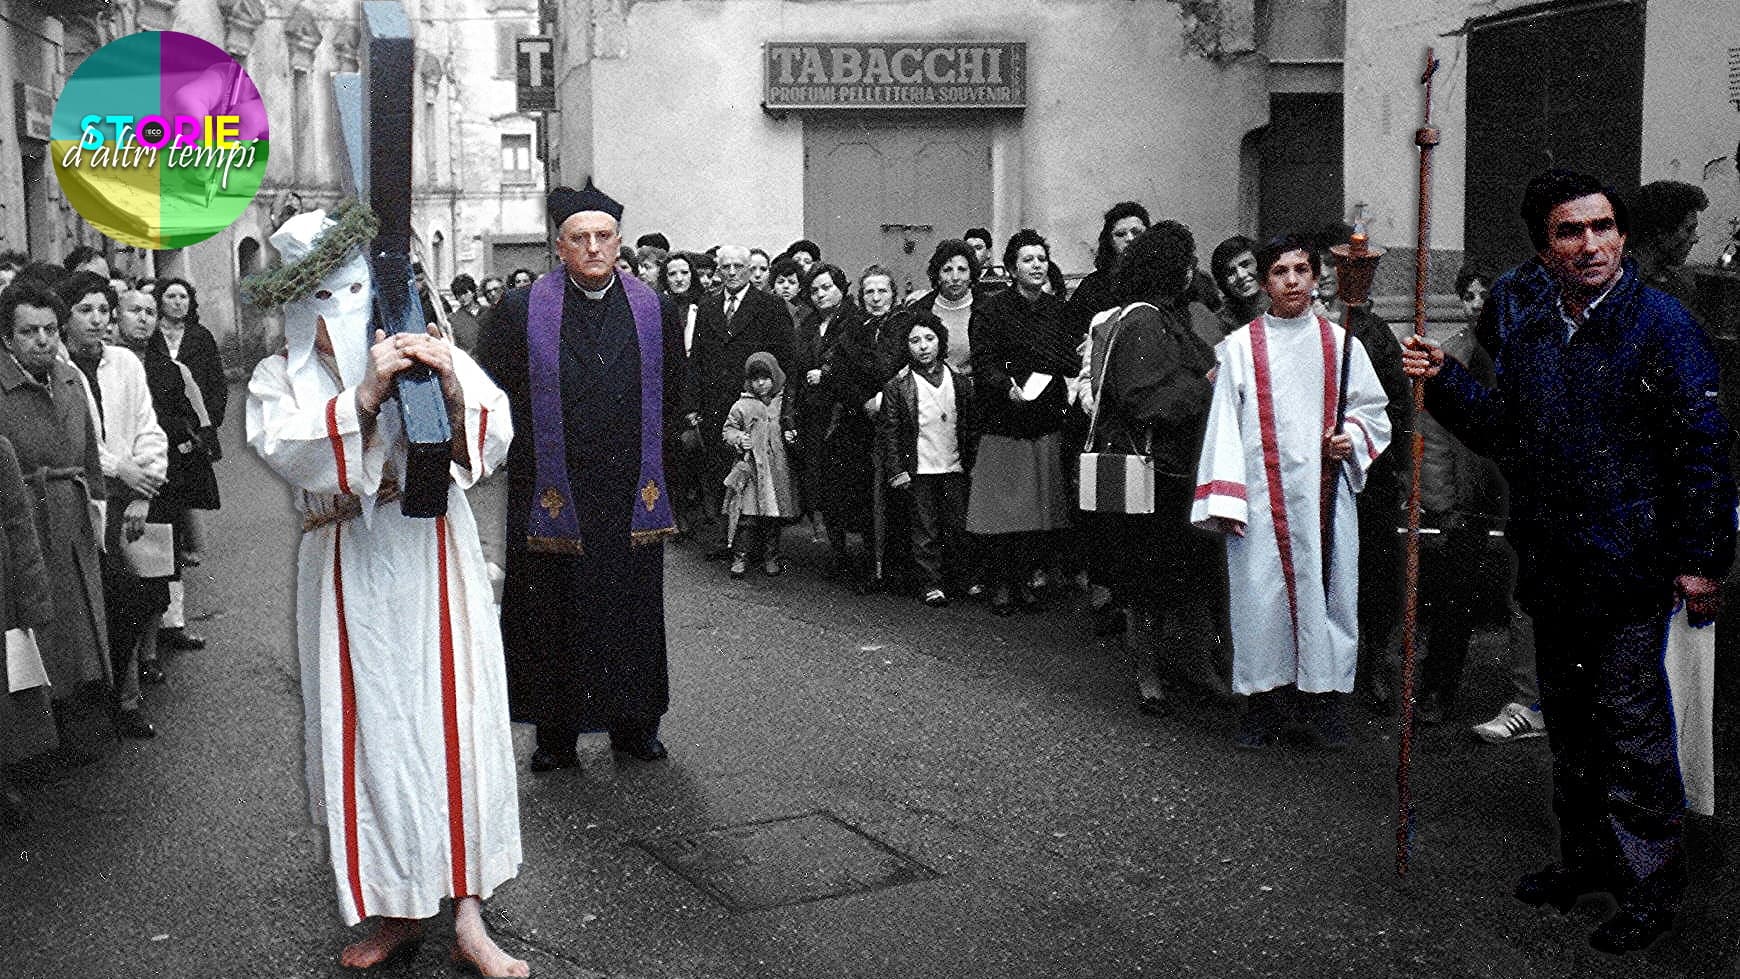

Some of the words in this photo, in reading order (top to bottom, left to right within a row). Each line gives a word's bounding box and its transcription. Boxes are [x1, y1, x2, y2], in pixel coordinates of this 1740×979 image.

[520, 41, 550, 87] T
[771, 48, 1002, 84] TABACCHI
[839, 86, 935, 101] PELLETTERIA
[939, 86, 1011, 101] SOUVENIR
